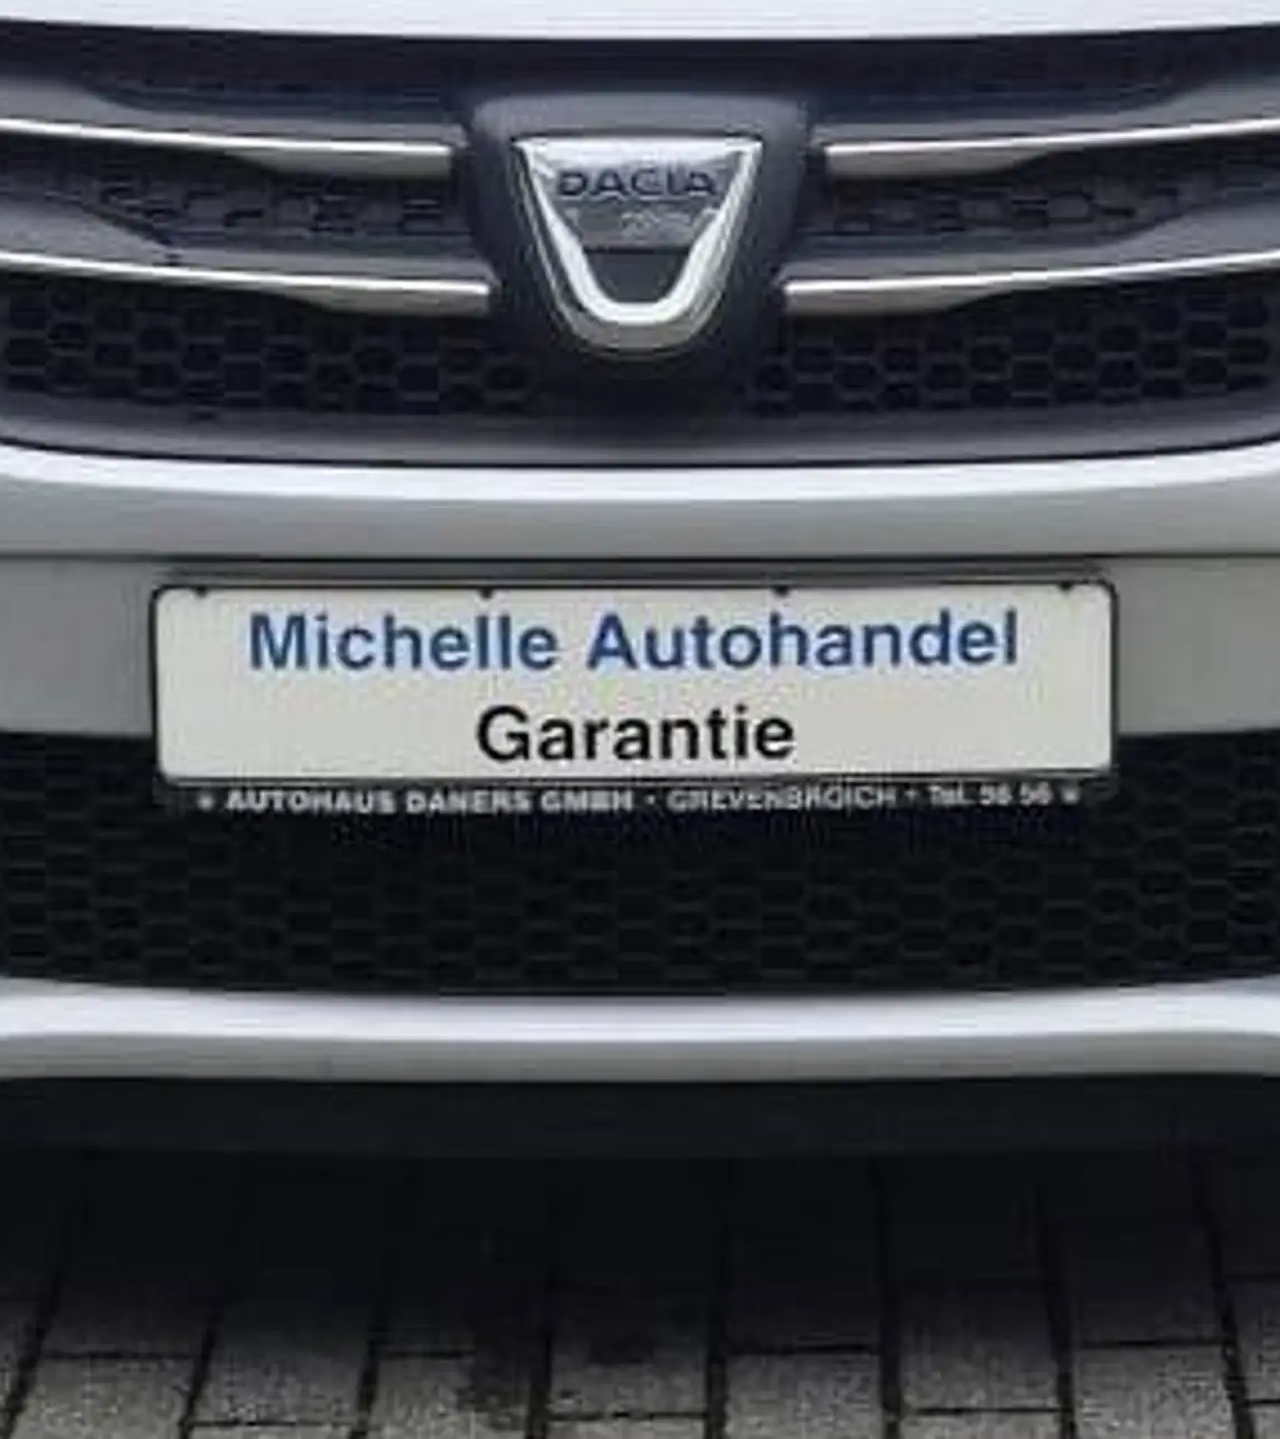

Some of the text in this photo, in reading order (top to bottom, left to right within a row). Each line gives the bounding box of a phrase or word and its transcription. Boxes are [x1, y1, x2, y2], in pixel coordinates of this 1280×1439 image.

[556, 168, 719, 197] DACIA
[249, 609, 1018, 671] Michelle Autohandel
[476, 704, 796, 763] Garantie
[226, 789, 397, 814] AUTOHAUS
[406, 789, 531, 814] DANERS
[665, 784, 898, 812] GREVENBROICH
